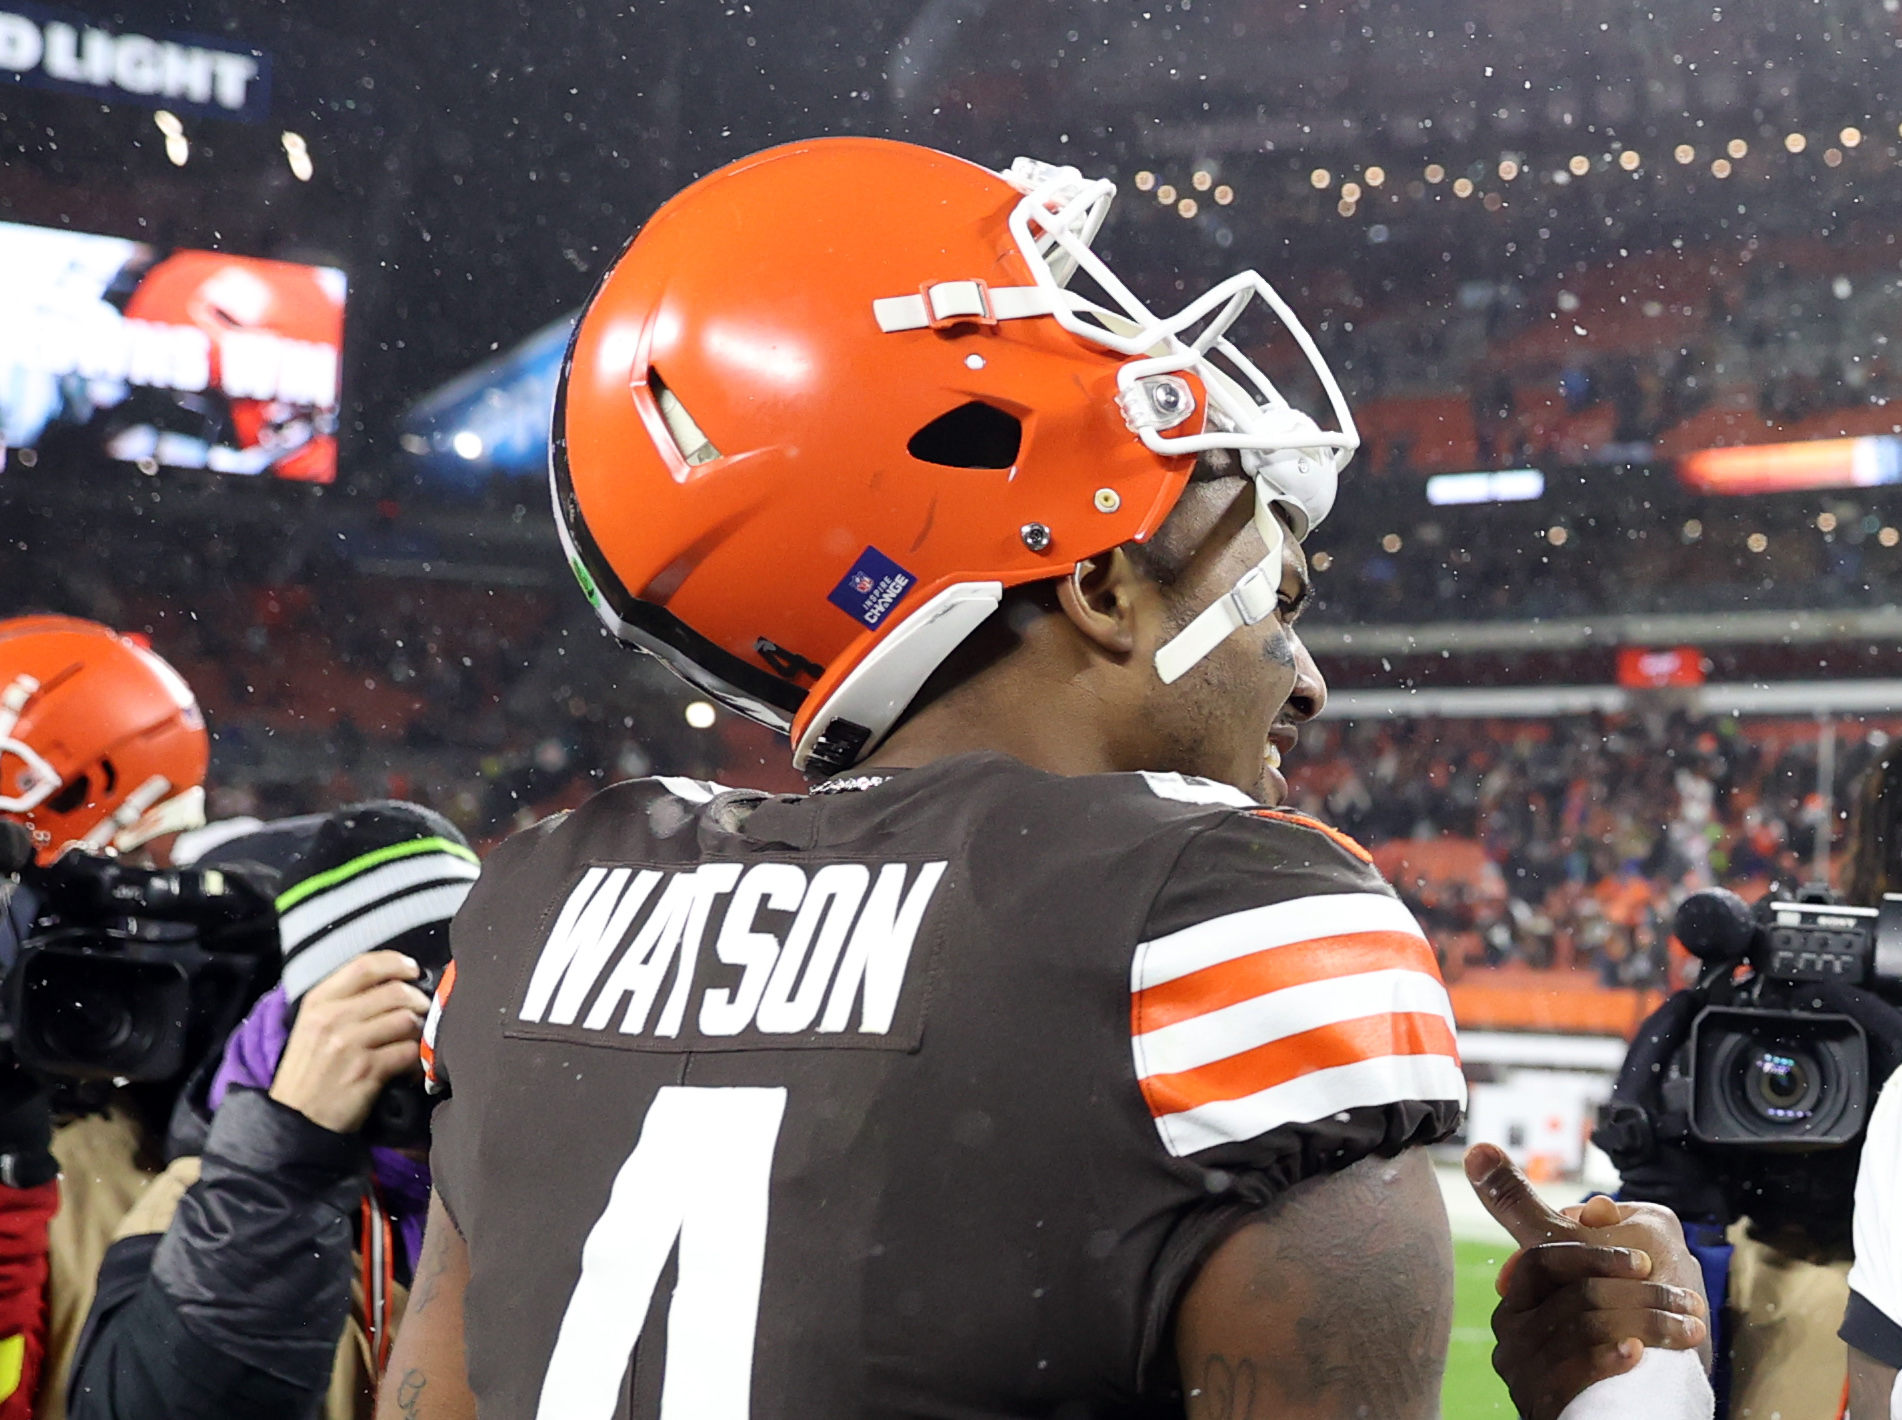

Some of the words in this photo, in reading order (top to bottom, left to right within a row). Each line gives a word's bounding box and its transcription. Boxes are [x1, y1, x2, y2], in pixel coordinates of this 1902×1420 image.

[43, 20, 259, 110] LIGHT
[862, 575, 892, 611] INSPIRE
[863, 573, 910, 624] CHANGE
[519, 860, 948, 1038] WATSON
